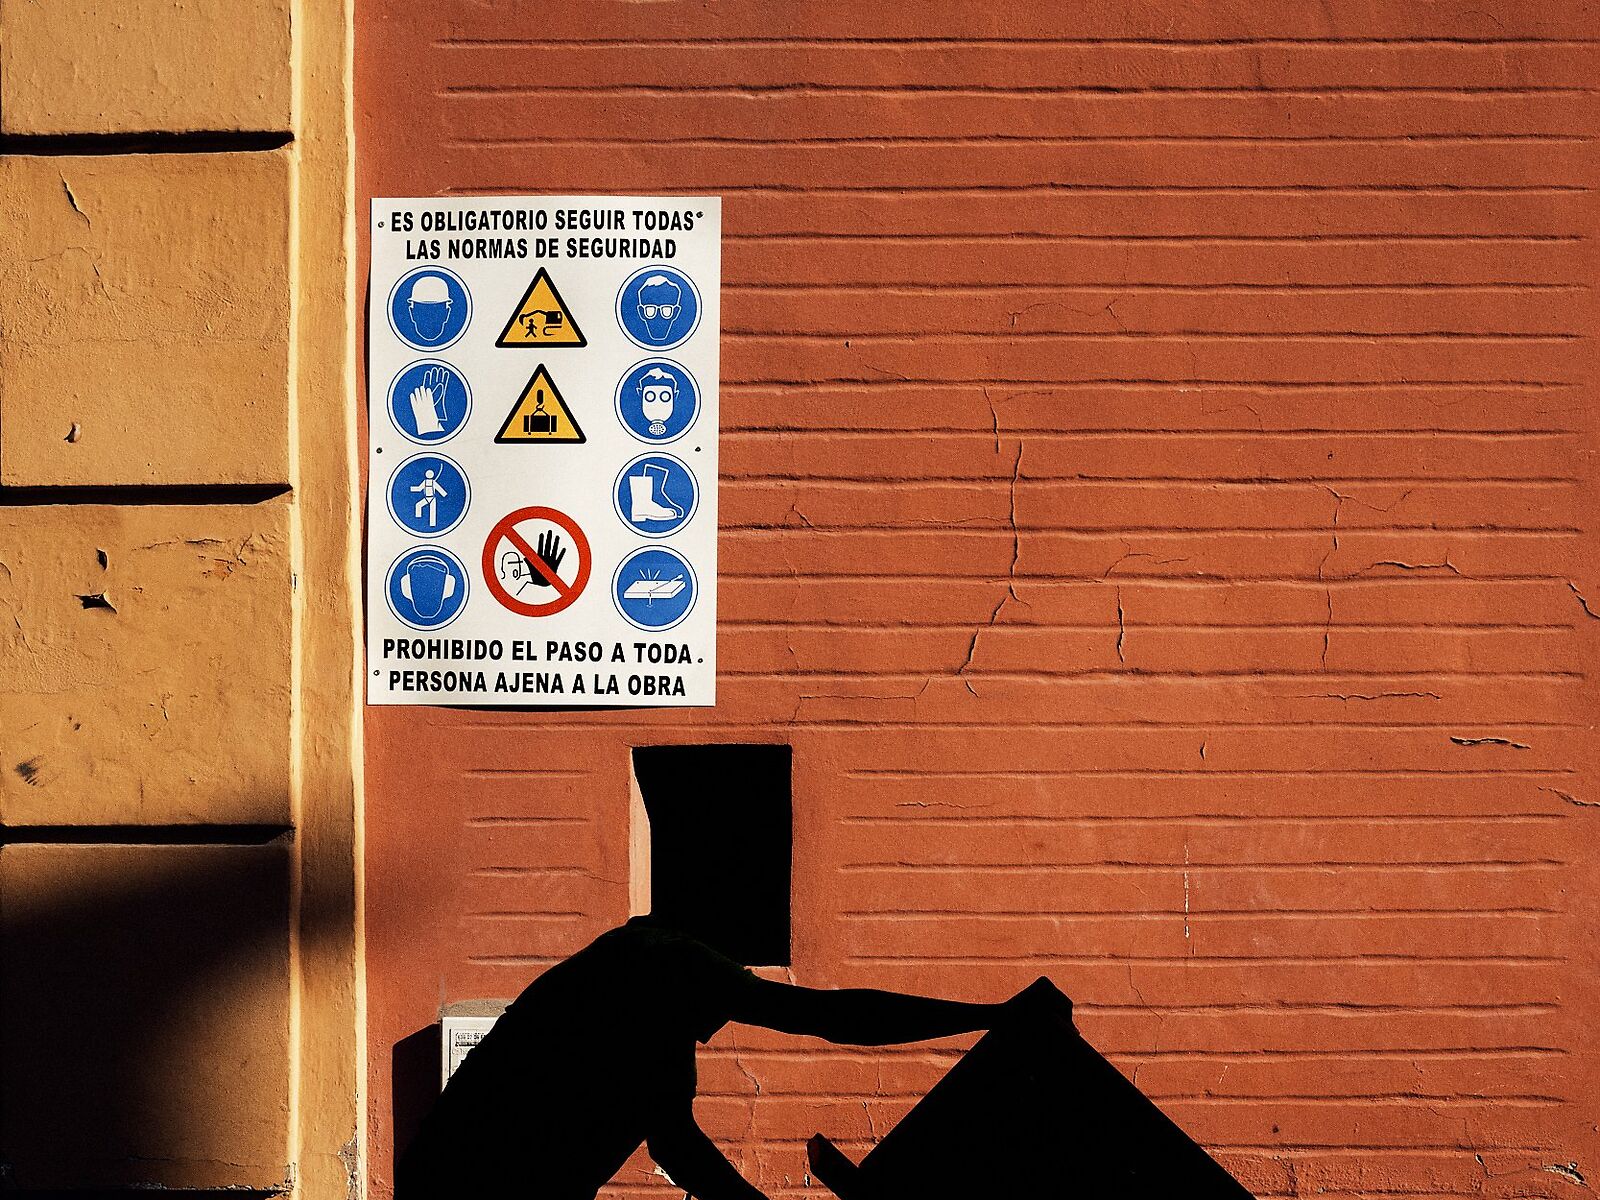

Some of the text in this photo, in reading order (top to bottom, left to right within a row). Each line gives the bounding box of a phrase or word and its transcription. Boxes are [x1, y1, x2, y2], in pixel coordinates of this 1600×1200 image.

[392, 210, 693, 231] ES OBLIGATORIO SEGUIR TODAS
[406, 238, 676, 260] LAS NORMAS DE SEGURIDAD
[384, 639, 692, 664] PROHIBIDO EL PASO A TODA
[389, 671, 686, 697] PERSONA AJENA A LA OBRA
